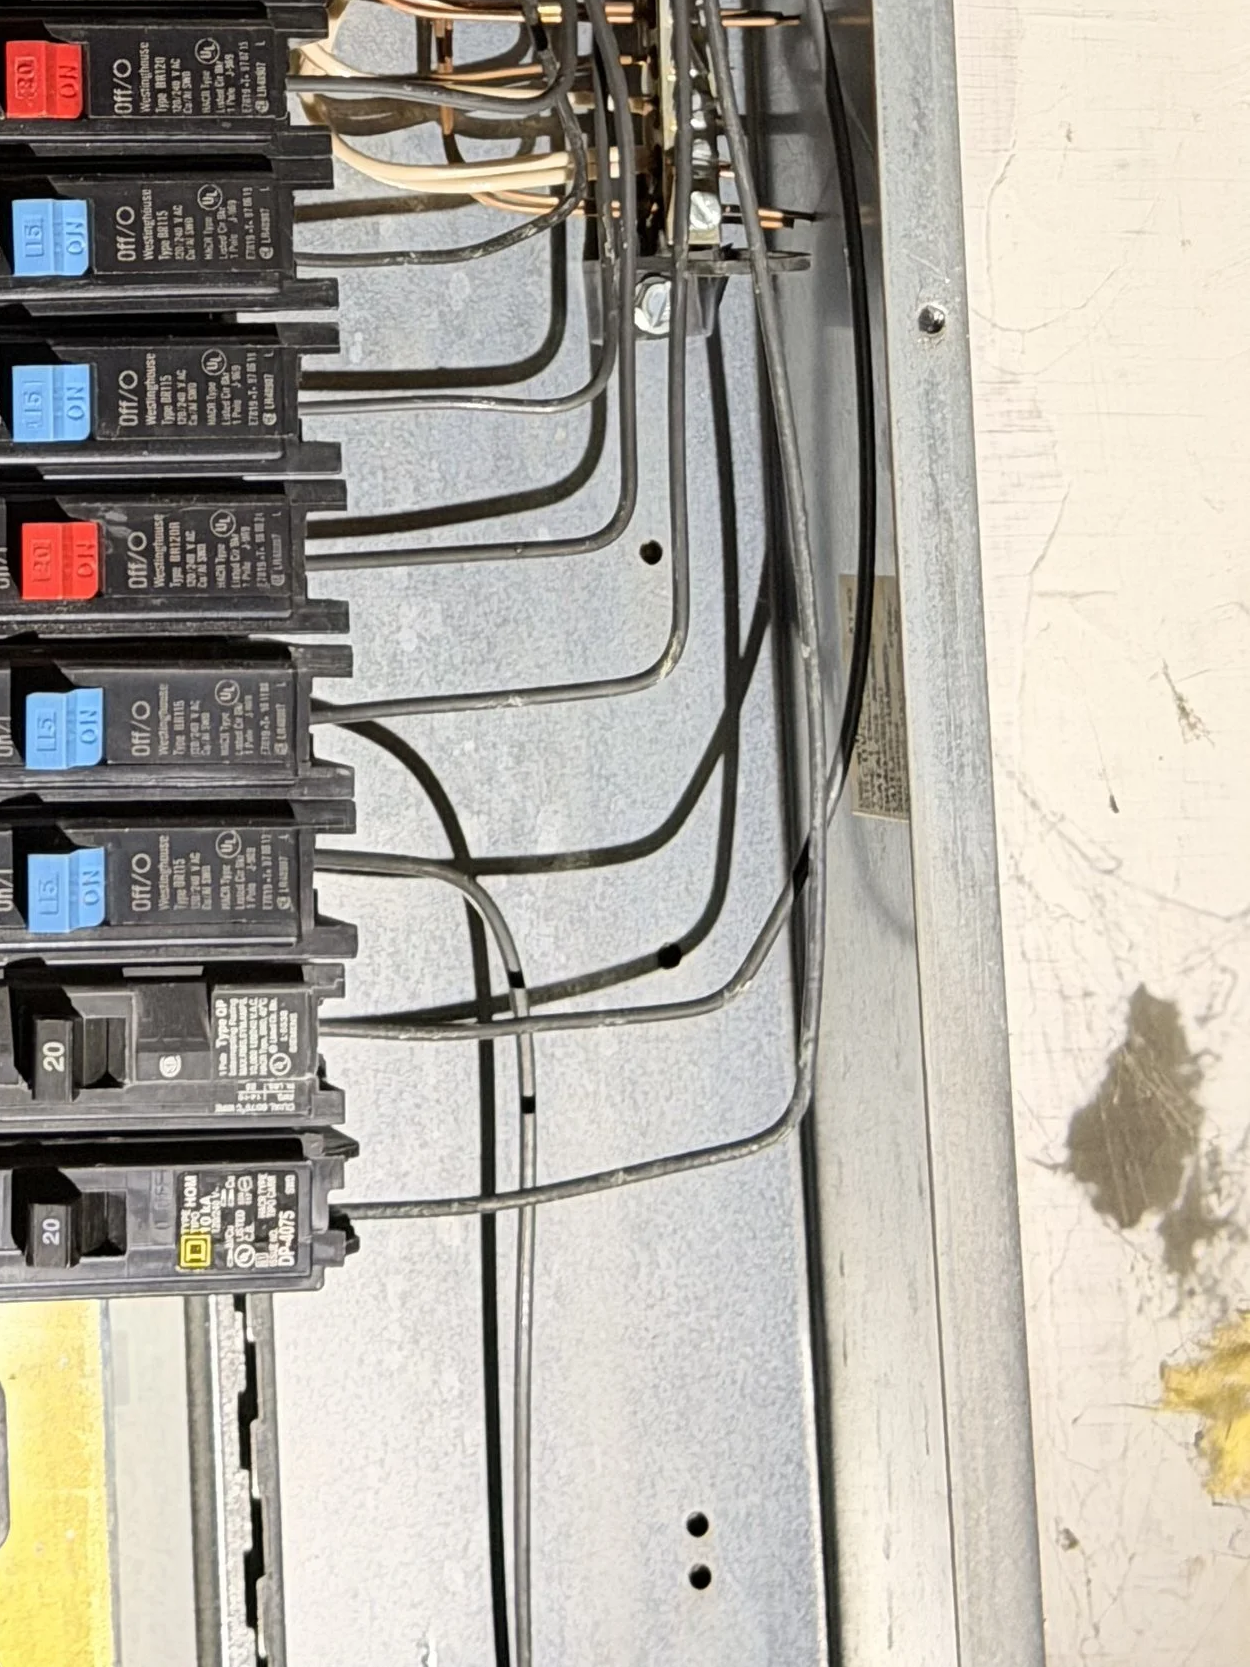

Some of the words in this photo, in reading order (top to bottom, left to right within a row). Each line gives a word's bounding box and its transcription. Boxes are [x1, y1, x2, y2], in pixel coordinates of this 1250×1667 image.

[58, 65, 77, 98] ON
[138, 42, 151, 113] Westinghouse
[155, 93, 168, 113] Type
[65, 220, 84, 256] ON
[141, 189, 155, 261] Westinghouse
[158, 240, 171, 261] Type
[66, 386, 84, 421] ON
[143, 353, 157, 426] Westinghouse
[160, 405, 174, 426] Type
[77, 542, 95, 578] ON
[153, 514, 167, 588] Westinghouse
[170, 567, 183, 587] Type
[79, 709, 98, 745] ON
[157, 683, 171, 756] Westinghouse
[174, 734, 187, 756] Type
[82, 870, 100, 906] ON
[157, 835, 171, 911] Westinghouse
[174, 889, 188, 910] Type
[215, 998, 228, 1018] QP
[215, 1018, 230, 1049] Type
[42, 1041, 66, 1072] 20
[183, 1175, 198, 1208] HOM
[198, 1194, 212, 1215] kA
[41, 1218, 61, 1245] 20
[180, 1210, 191, 1235] TYPE
[199, 1215, 211, 1234] 10
[235, 1210, 247, 1243] LISTED
[277, 1210, 296, 1267] DP-4075
